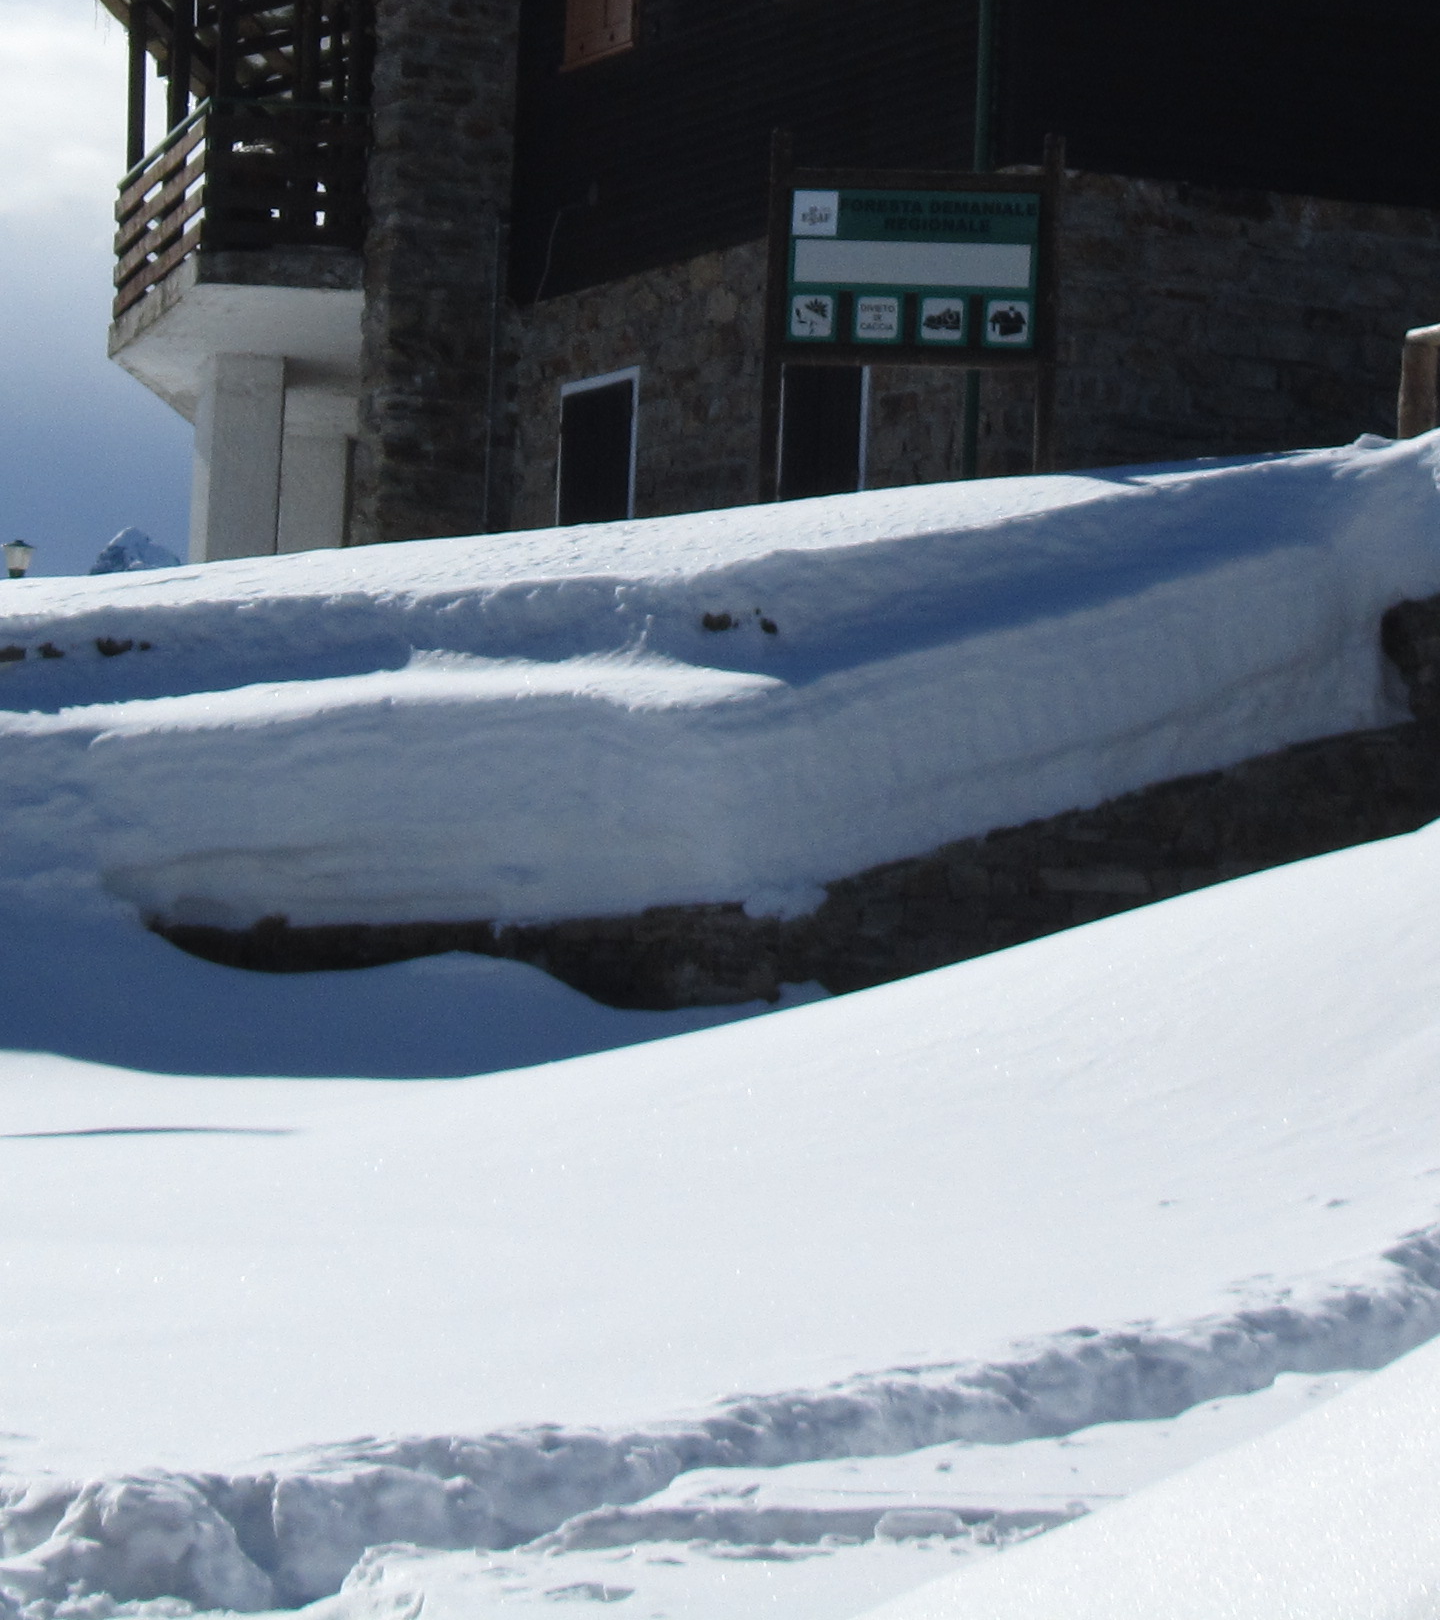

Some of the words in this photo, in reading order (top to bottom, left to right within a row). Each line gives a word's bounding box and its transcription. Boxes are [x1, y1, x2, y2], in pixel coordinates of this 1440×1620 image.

[841, 199, 925, 214] FORESTA
[930, 200, 1038, 216] DEMANIALE
[884, 217, 991, 232] REGIONALE
